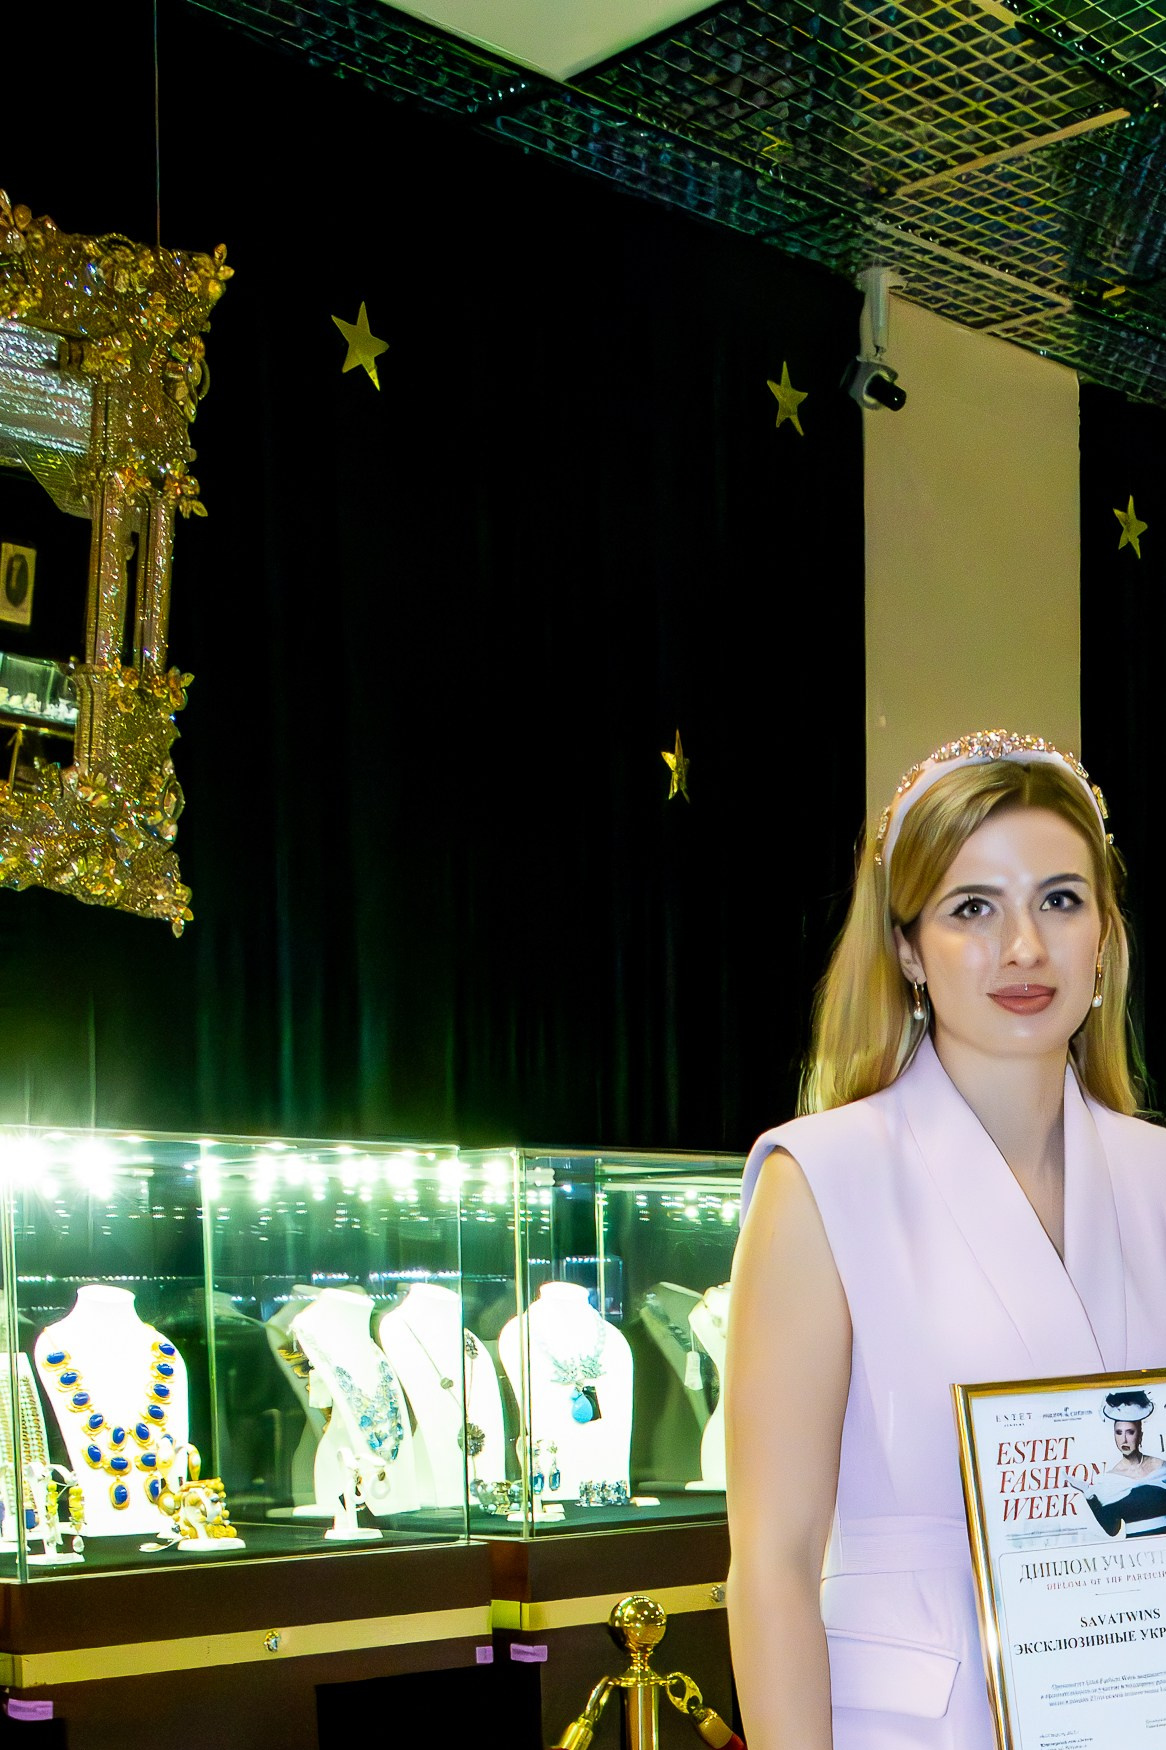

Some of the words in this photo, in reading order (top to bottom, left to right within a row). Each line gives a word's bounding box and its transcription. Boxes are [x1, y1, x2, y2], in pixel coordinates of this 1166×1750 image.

[997, 1436, 1075, 1465] ESTET
[999, 1461, 1106, 1493] FASHION
[1003, 1492, 1079, 1521] WEEK
[1019, 1556, 1098, 1584] ДИПЛОМ
[1046, 1580, 1087, 1591] DIPLOMA
[1080, 1607, 1161, 1628] SAVATWINS
[1014, 1629, 1137, 1656] ЭКСКЛЮЗИВНЫЕ
